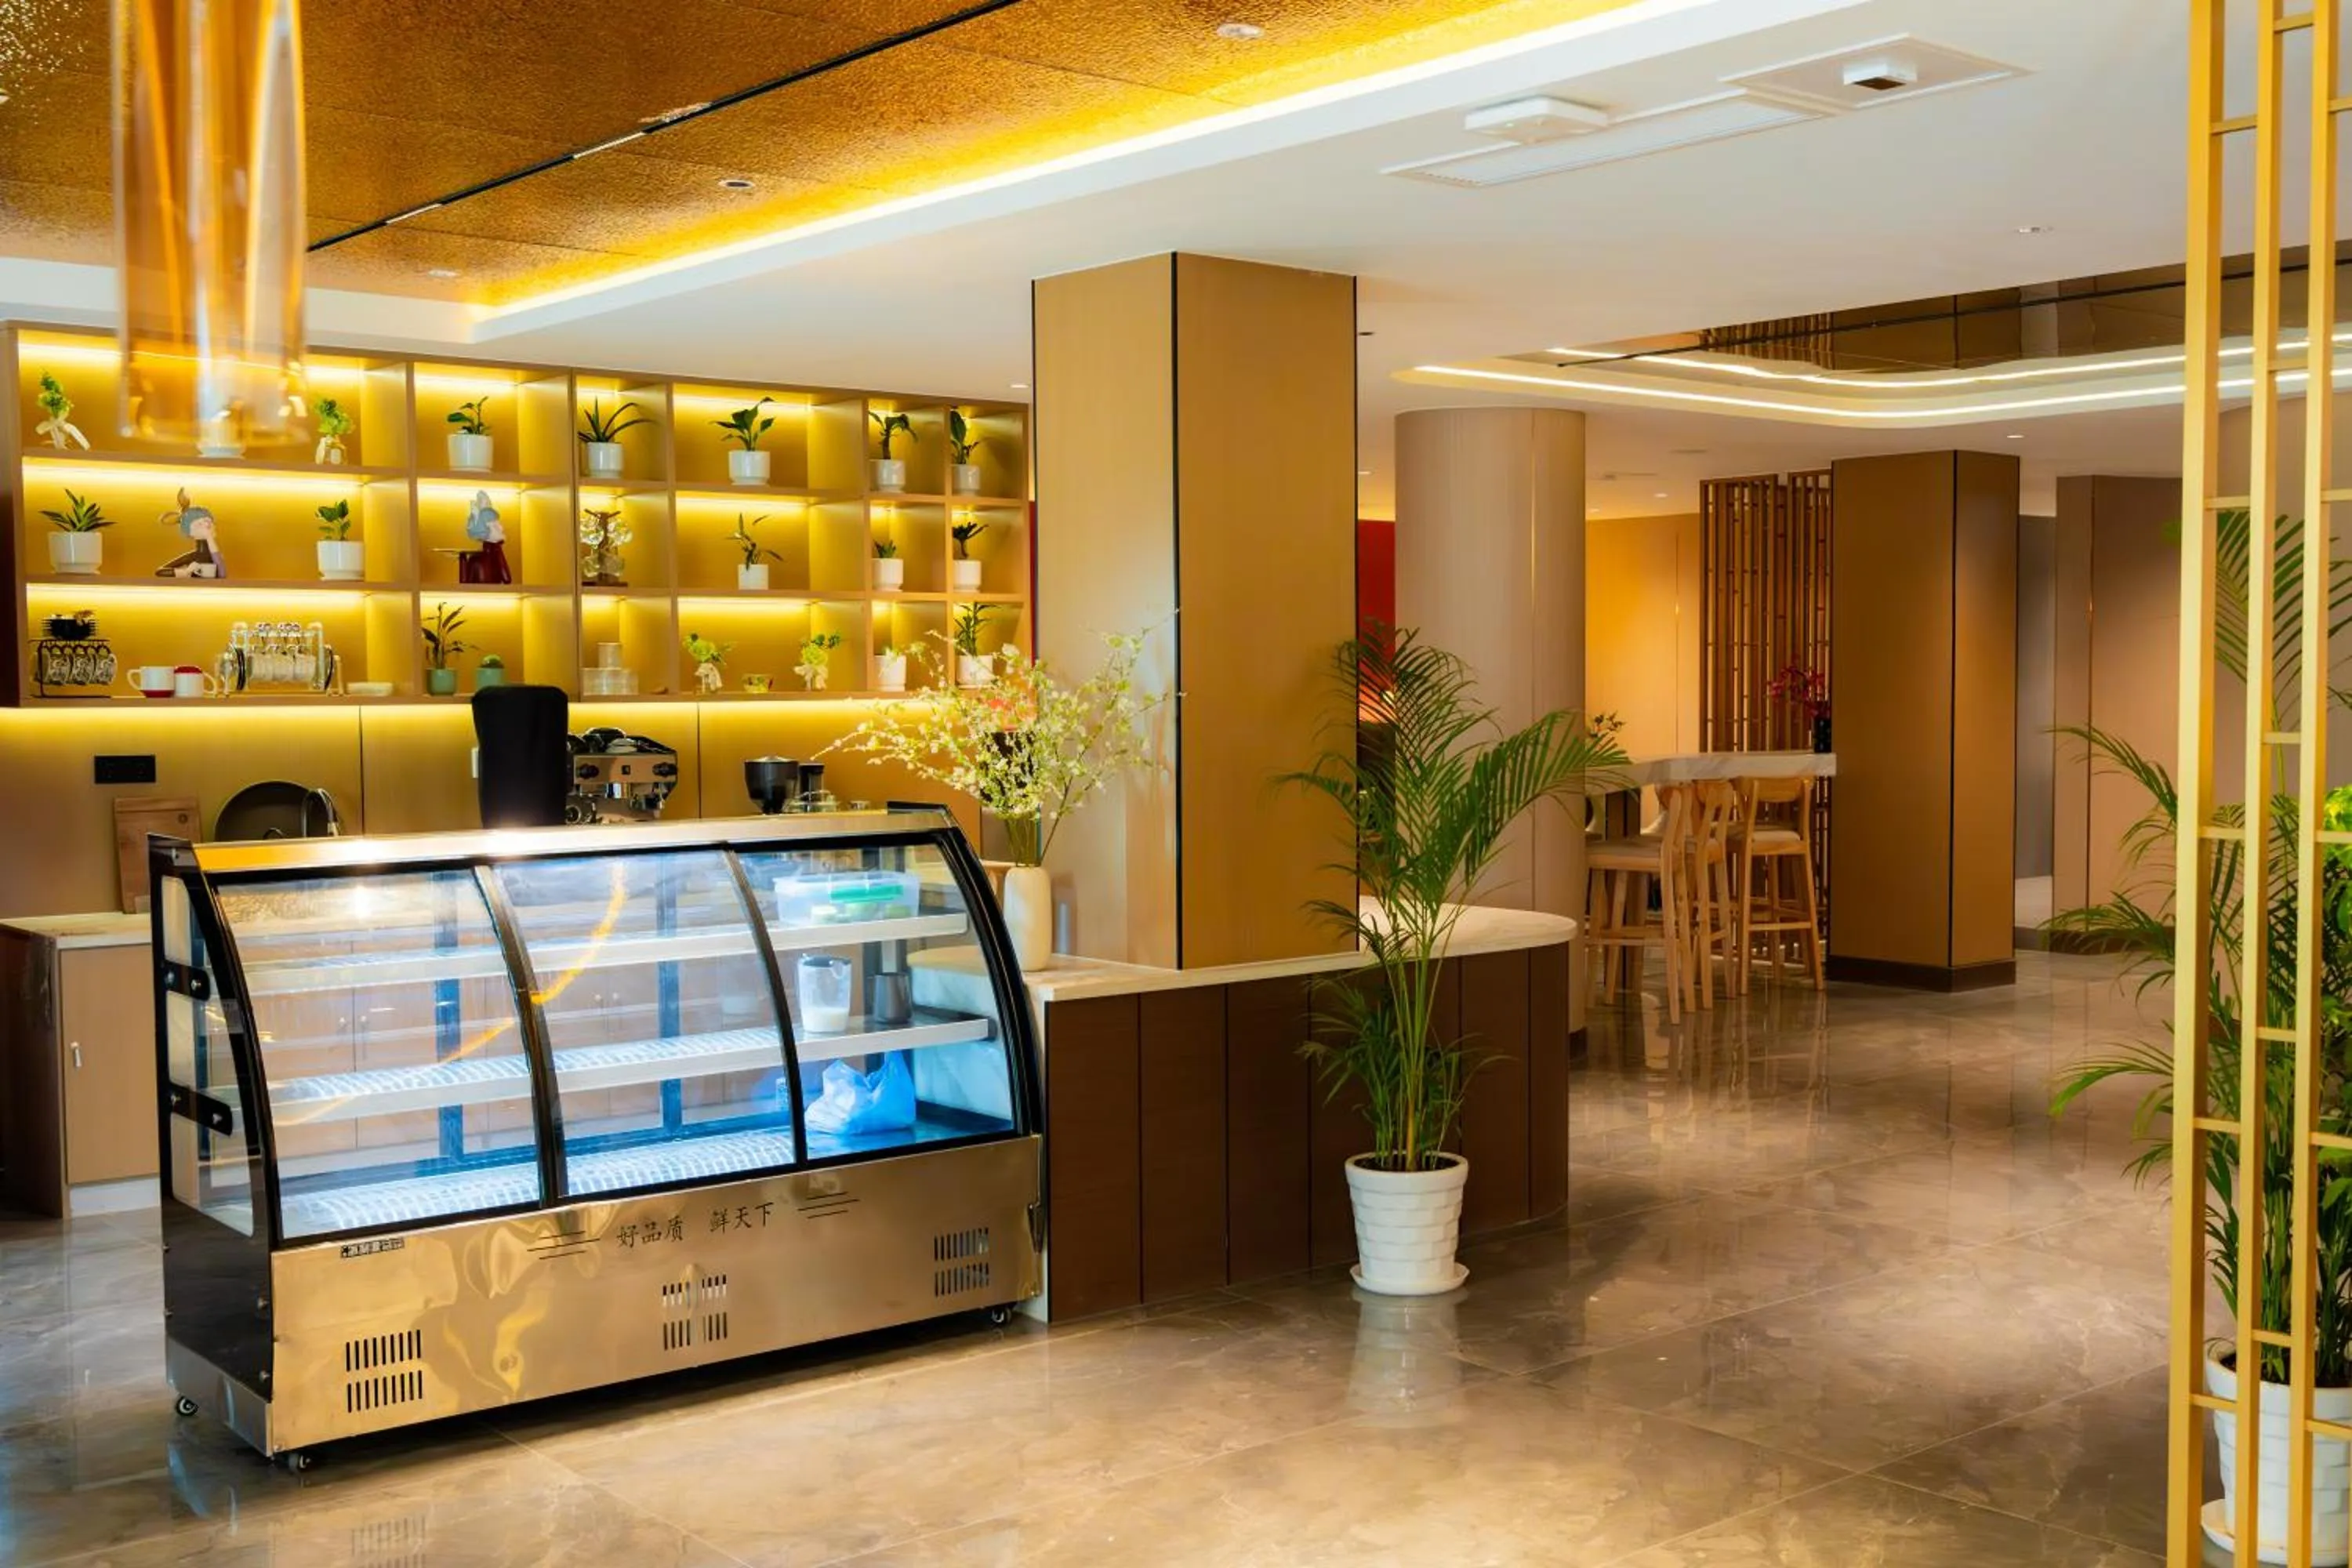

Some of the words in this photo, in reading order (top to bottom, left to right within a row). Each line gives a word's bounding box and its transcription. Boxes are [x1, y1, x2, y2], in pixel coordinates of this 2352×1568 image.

[616, 1214, 684, 1248] 好品质
[710, 1202, 774, 1234] 鲜天下
